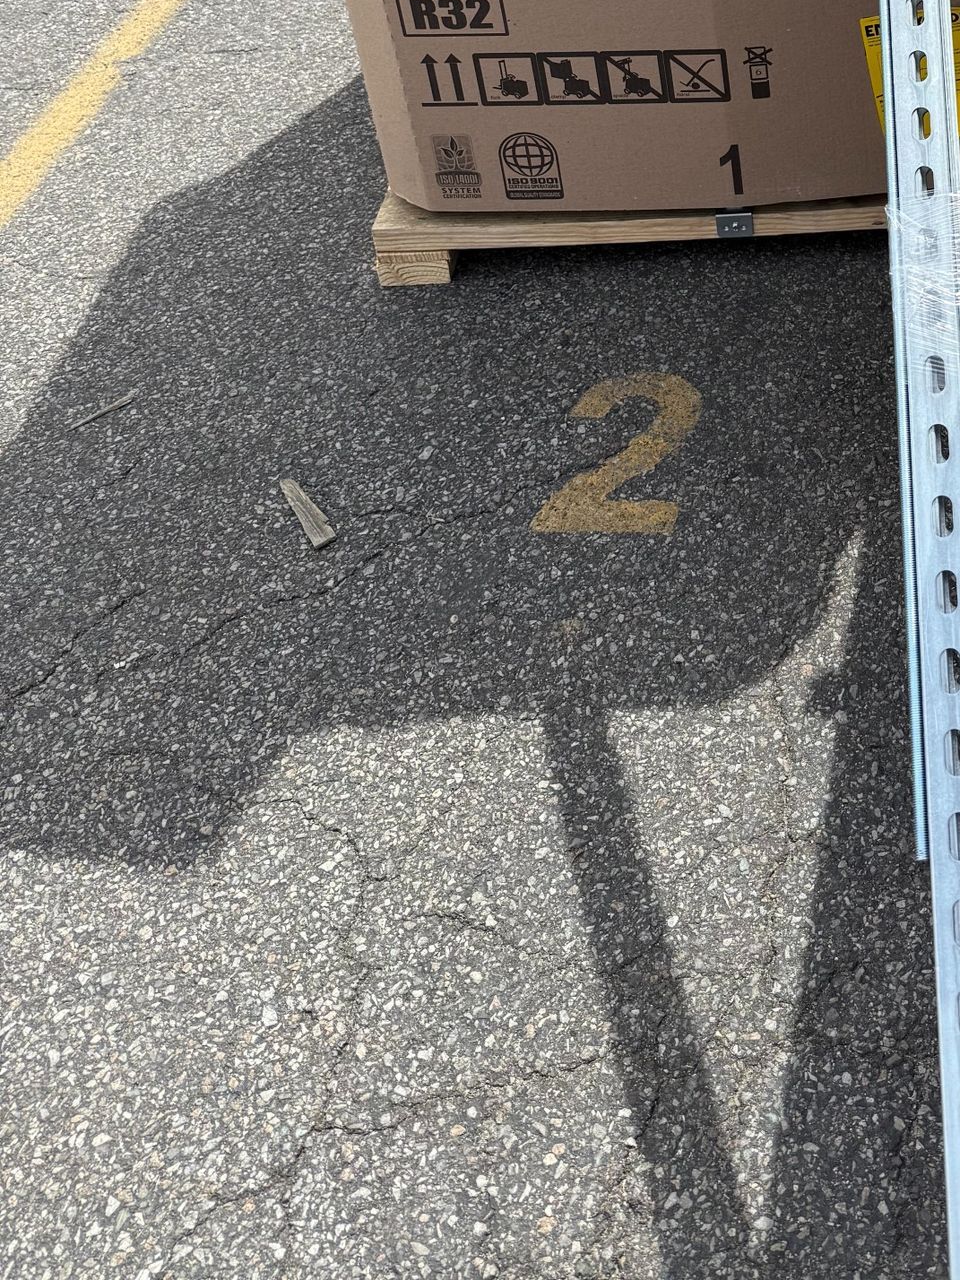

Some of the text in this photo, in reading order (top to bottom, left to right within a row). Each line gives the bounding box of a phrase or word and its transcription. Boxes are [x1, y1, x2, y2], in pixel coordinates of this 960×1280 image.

[440, 174, 454, 184] ISO
[508, 177, 529, 185] ISO
[719, 144, 744, 195] 1
[529, 372, 702, 536] 2
